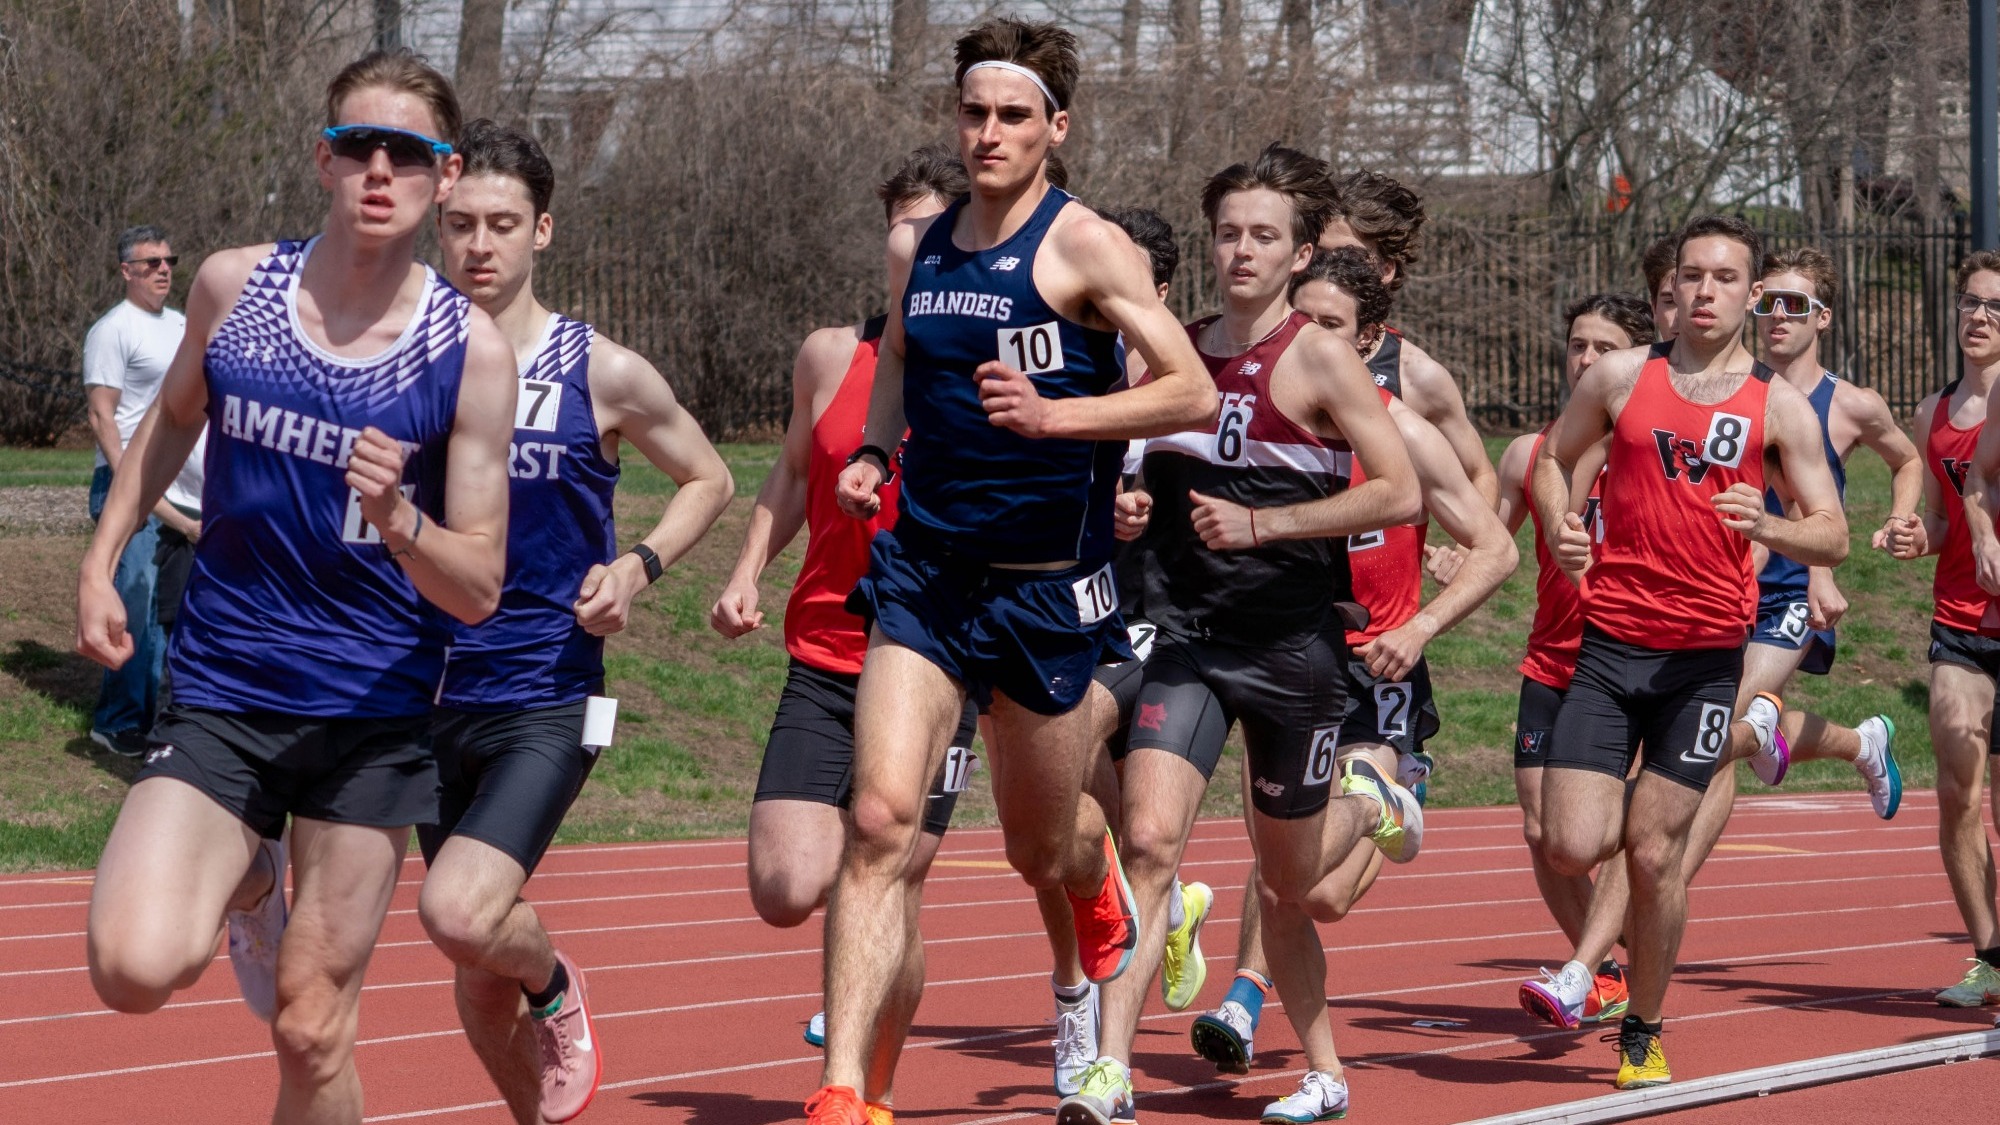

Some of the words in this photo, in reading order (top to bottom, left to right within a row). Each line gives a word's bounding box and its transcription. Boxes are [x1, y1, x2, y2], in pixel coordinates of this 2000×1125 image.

[909, 291, 1013, 321] BRANDEIS
[1008, 327, 1053, 372] 10
[524, 382, 552, 428] 7
[1217, 410, 1243, 463] 6
[1709, 417, 1742, 462] 8
[1084, 569, 1112, 620] 10
[1379, 685, 1406, 731] 2
[1700, 708, 1726, 754] 8
[1311, 732, 1334, 781] 6
